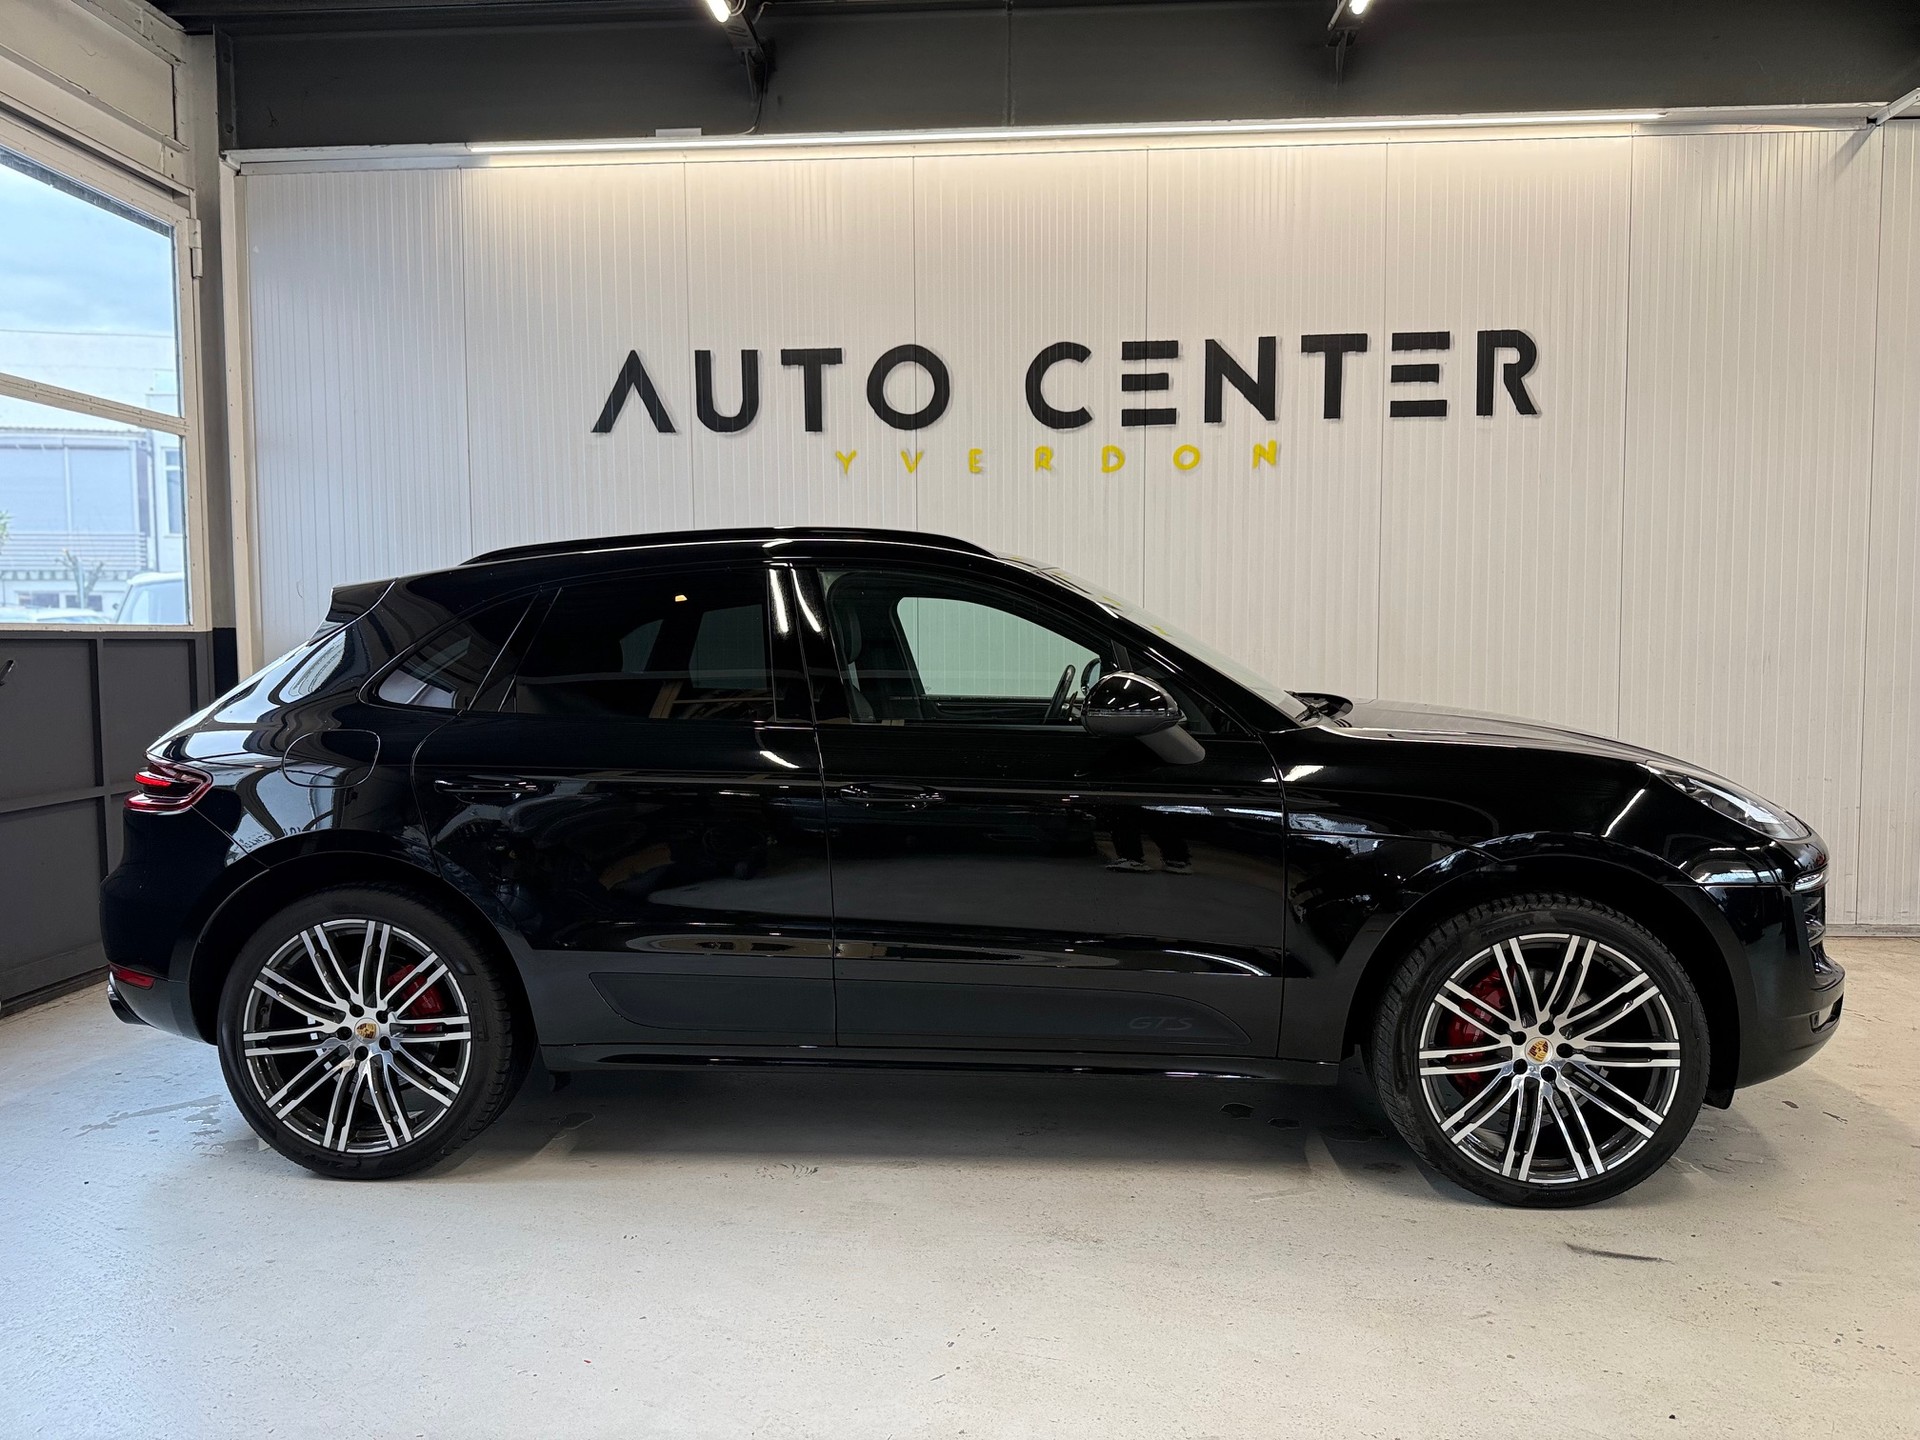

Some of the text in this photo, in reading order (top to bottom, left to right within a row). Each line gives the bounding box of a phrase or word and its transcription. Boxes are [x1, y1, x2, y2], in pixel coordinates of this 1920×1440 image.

[592, 330, 1538, 434] AUTO CENTER
[834, 440, 1278, 475] YVERDON
[1128, 1016, 1195, 1031] GTS
